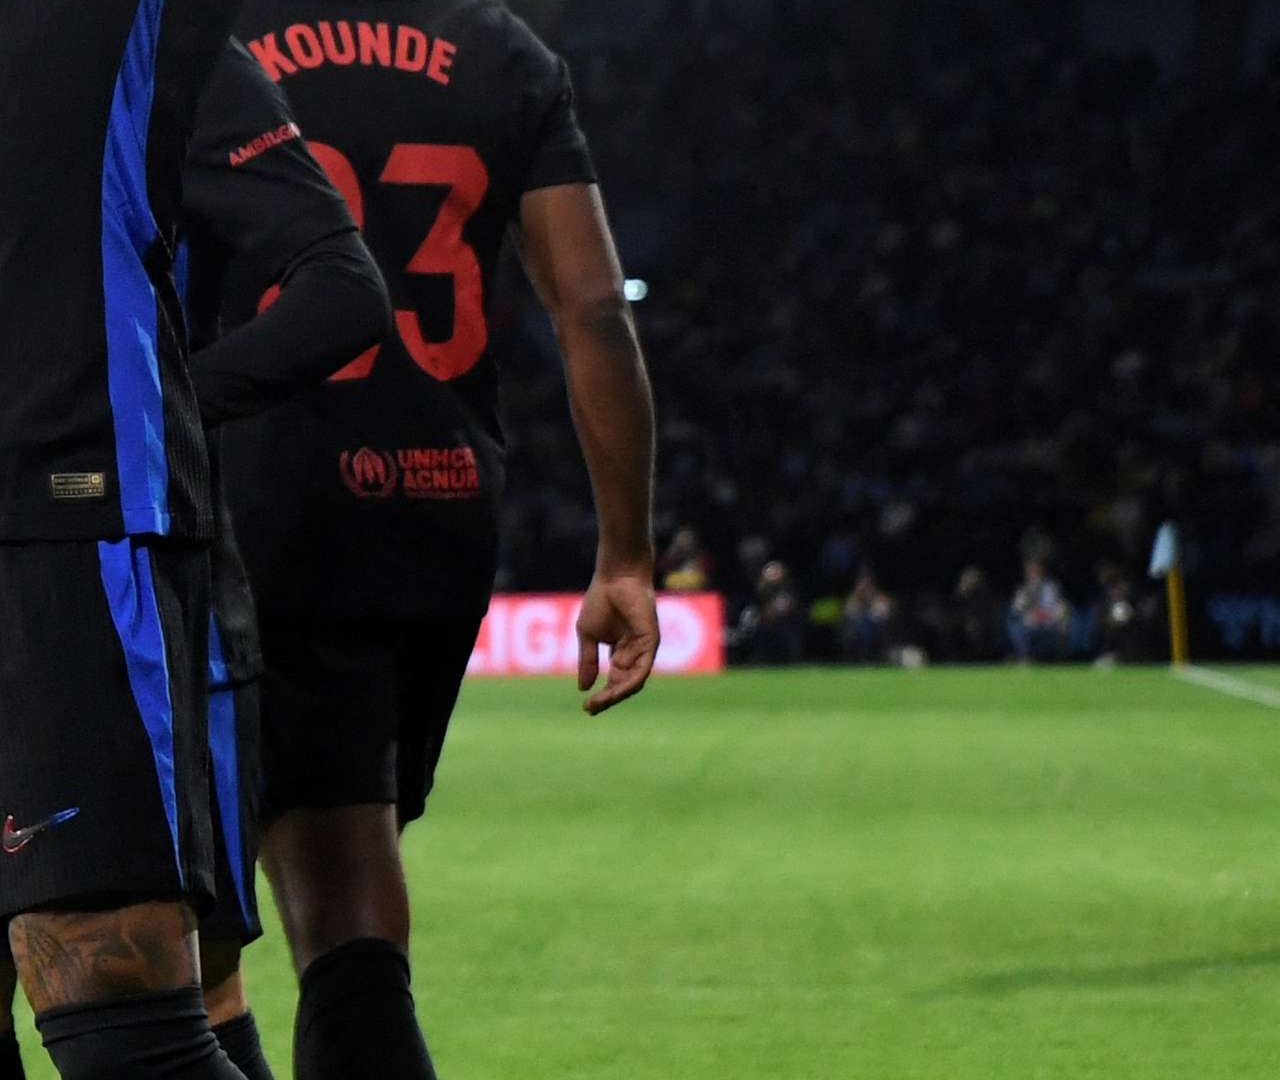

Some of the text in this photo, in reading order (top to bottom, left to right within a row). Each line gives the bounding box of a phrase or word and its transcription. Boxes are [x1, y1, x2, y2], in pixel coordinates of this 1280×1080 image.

[248, 20, 457, 85] KOUNDE
[397, 447, 476, 467] UNHCR
[403, 470, 480, 489] ACNUR
